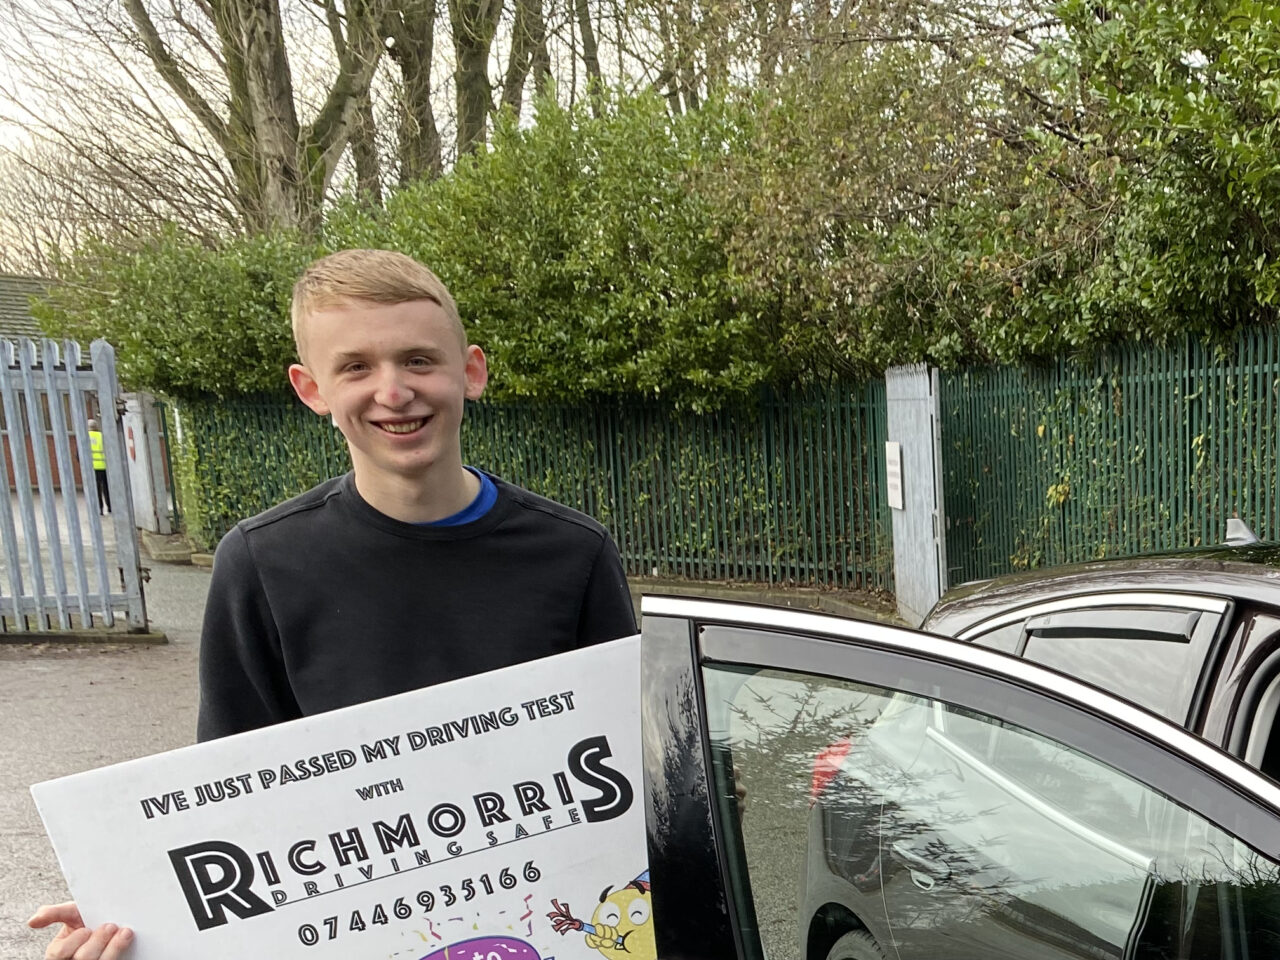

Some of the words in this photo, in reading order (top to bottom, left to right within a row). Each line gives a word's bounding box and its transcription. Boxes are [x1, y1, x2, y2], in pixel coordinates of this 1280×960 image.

[140, 790, 190, 820] IVE
[195, 774, 253, 807] JUST
[257, 749, 357, 790] PASSED
[361, 735, 401, 764] MY
[406, 706, 519, 752] DRIVING
[521, 690, 576, 721] TEST
[355, 778, 404, 801] WITH
[167, 735, 634, 932] RICHMORRIS
[298, 860, 541, 946] 07446935166
